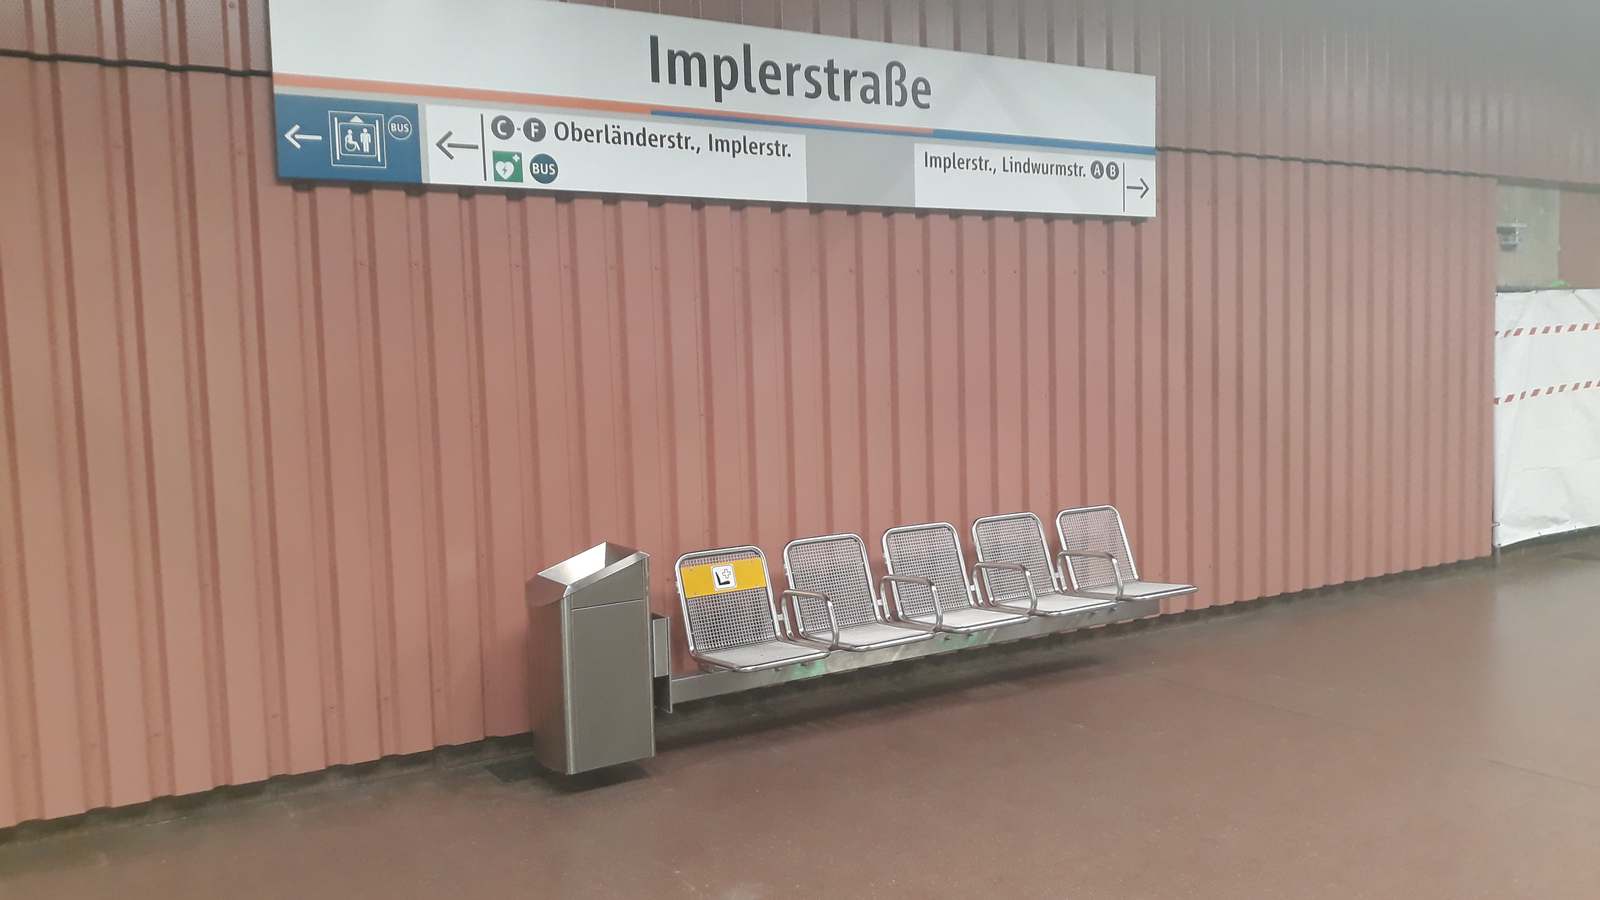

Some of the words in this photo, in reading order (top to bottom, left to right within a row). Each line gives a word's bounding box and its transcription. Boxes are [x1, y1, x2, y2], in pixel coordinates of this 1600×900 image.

[649, 34, 932, 109] Implerstraße
[390, 122, 410, 134] BUS
[553, 120, 701, 155] Oberländerstr.,
[708, 133, 792, 158] Implerstr.
[532, 162, 556, 176] BUS
[924, 151, 997, 175] Implerstr.,
[1002, 156, 1086, 178] Lindwurmstr.
